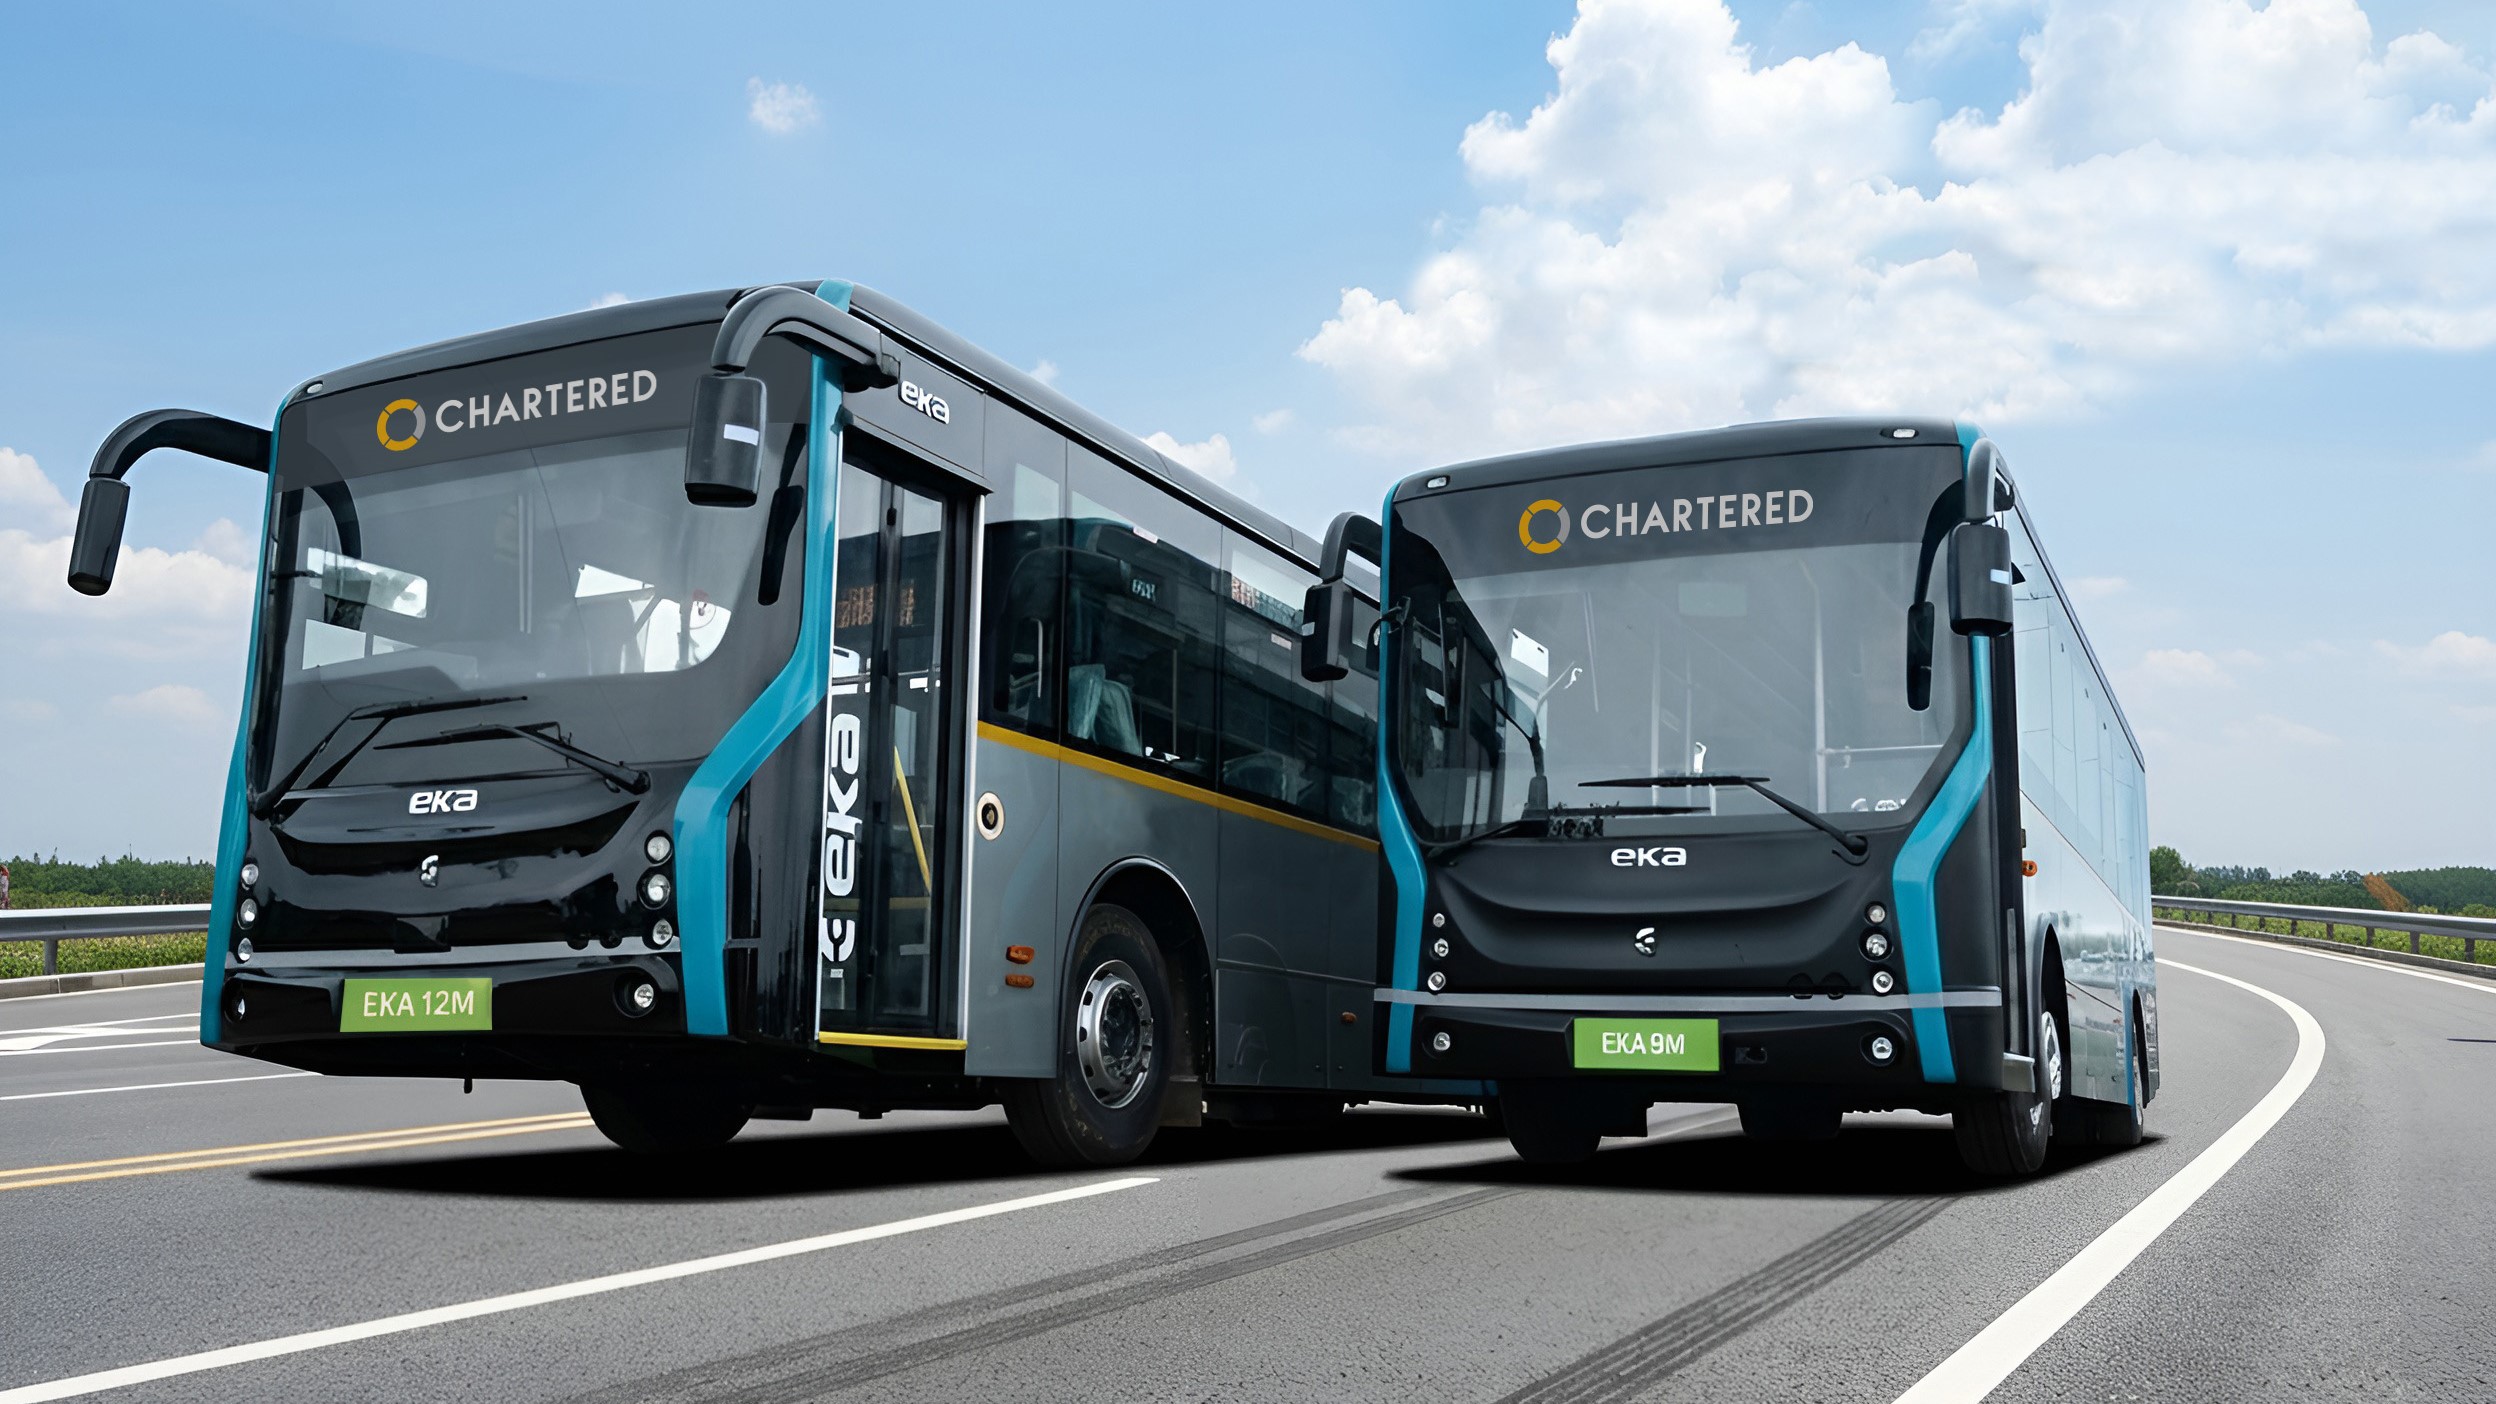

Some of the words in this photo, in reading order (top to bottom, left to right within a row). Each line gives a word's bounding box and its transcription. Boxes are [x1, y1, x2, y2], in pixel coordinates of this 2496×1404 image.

[434, 369, 658, 434] CHARTERED
[900, 380, 950, 425] eka
[1580, 489, 1815, 539] CHARTERED
[408, 789, 478, 814] eka
[825, 713, 862, 897] eka
[1610, 847, 1687, 867] eka
[363, 991, 415, 1017] EKA
[421, 990, 474, 1016] 12M
[1602, 1032, 1647, 1055] EKA
[1650, 1032, 1685, 1055] 9M
